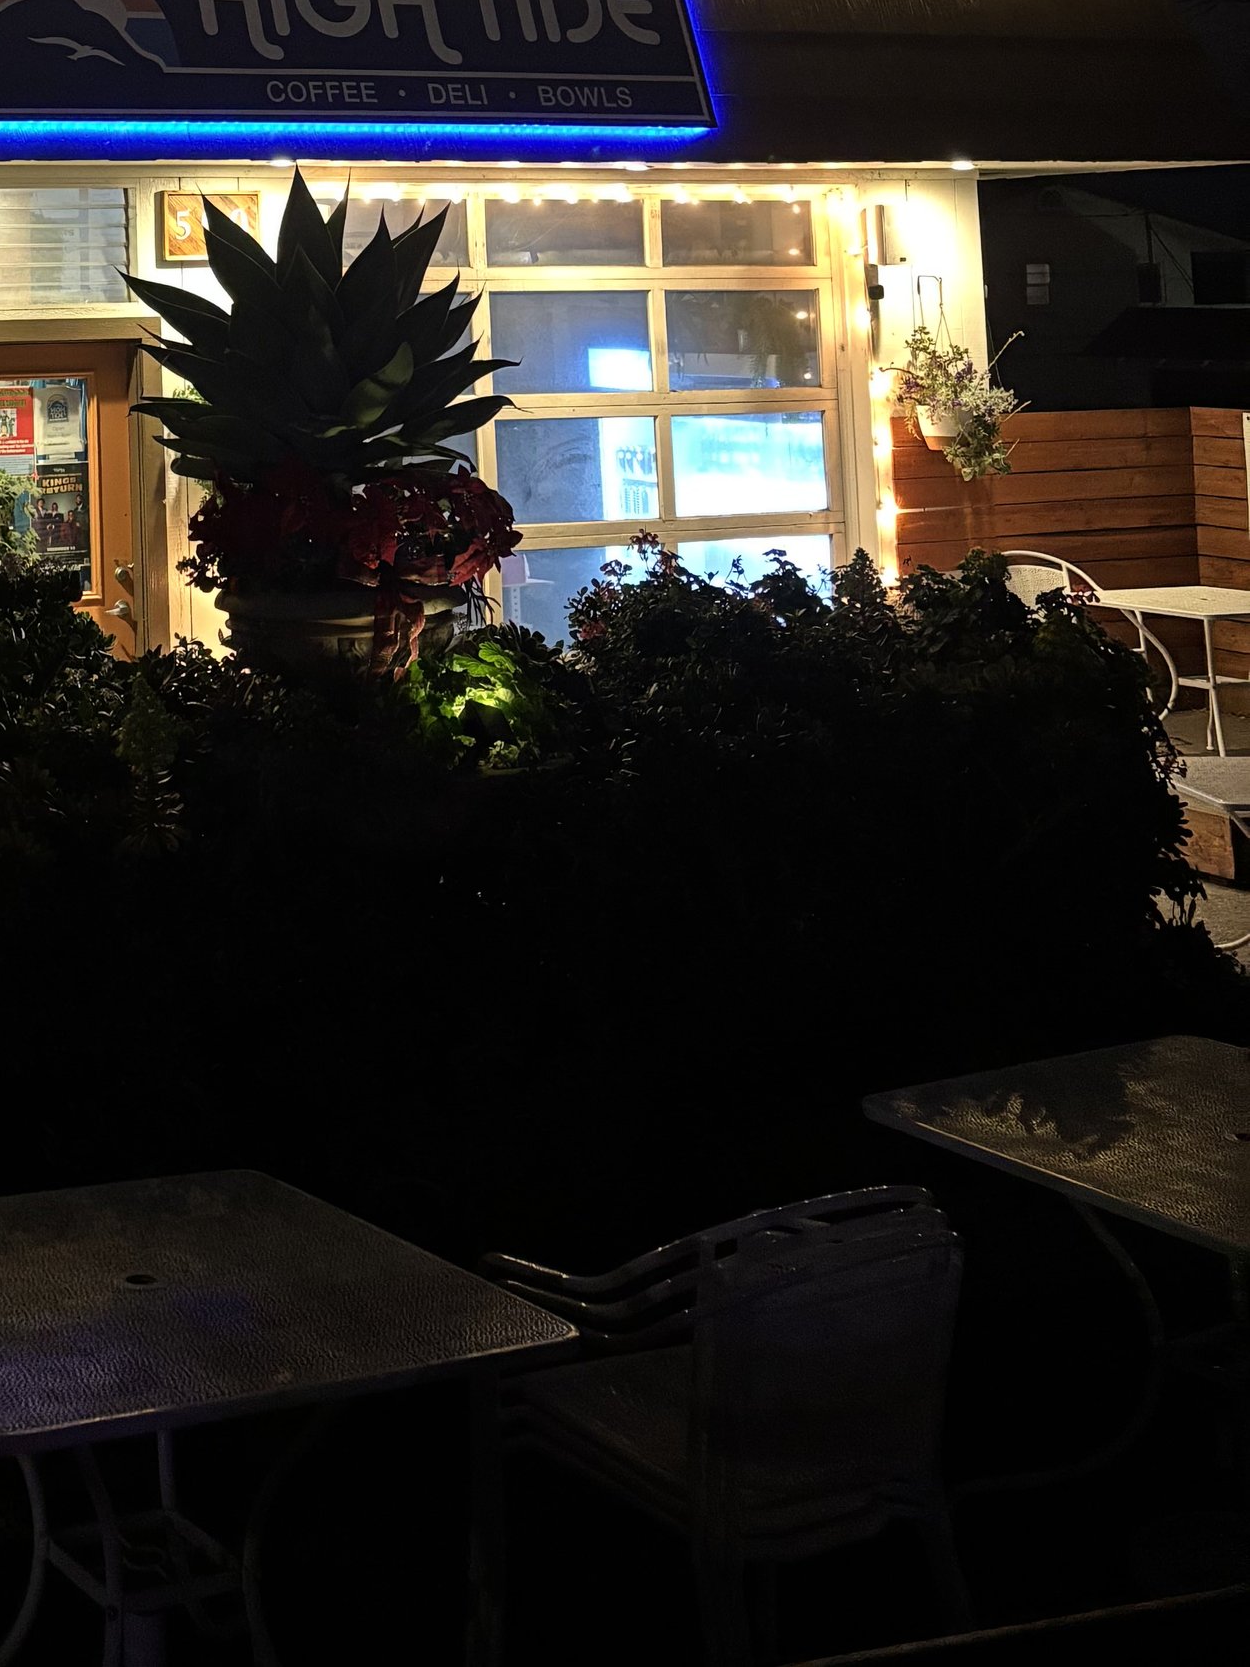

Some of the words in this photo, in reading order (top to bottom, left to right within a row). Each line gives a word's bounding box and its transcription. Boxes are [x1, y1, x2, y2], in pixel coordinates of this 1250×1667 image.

[266, 79, 378, 104] COFFEE
[427, 82, 489, 106] DELI
[537, 84, 634, 108] BOWLS
[41, 476, 77, 487] KINGS
